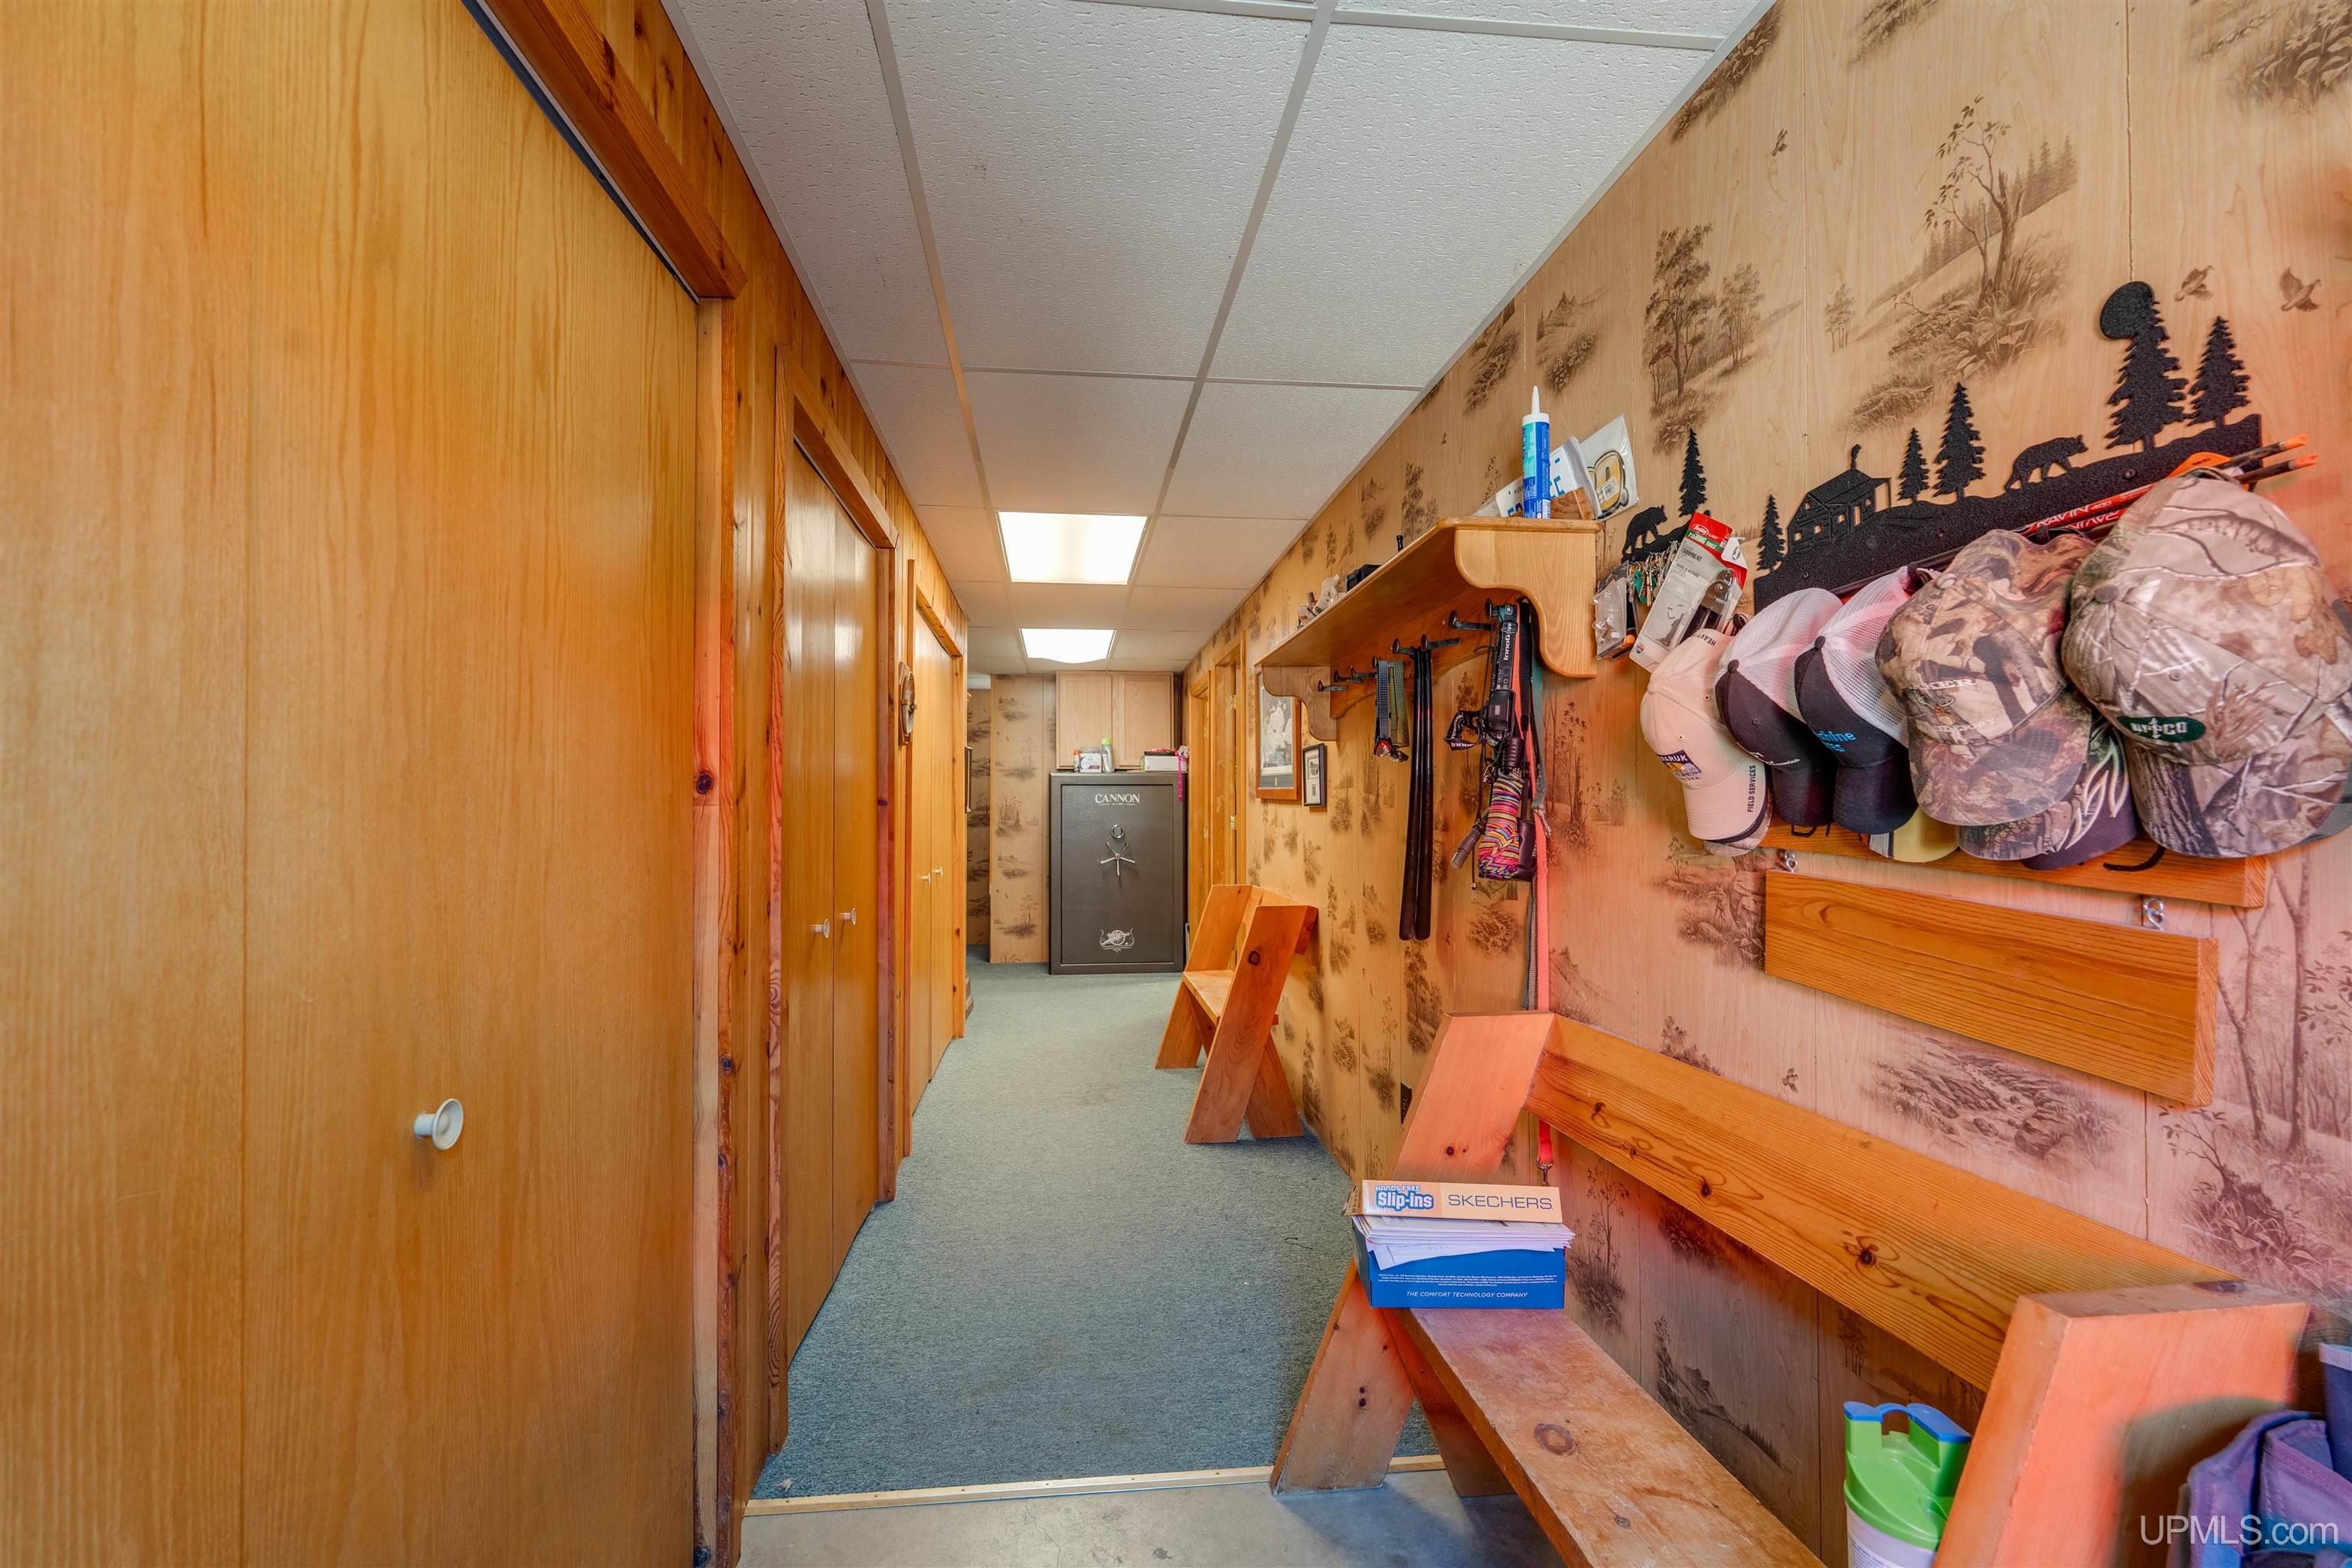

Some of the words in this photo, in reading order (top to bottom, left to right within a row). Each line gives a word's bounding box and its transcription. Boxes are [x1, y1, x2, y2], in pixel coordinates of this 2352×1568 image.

[2037, 505, 2089, 528] RAVIN
[1095, 793, 1140, 803] CANNON
[1377, 1191, 1432, 1210] Slip-ins
[1448, 1194, 1553, 1210] SKECHERS
